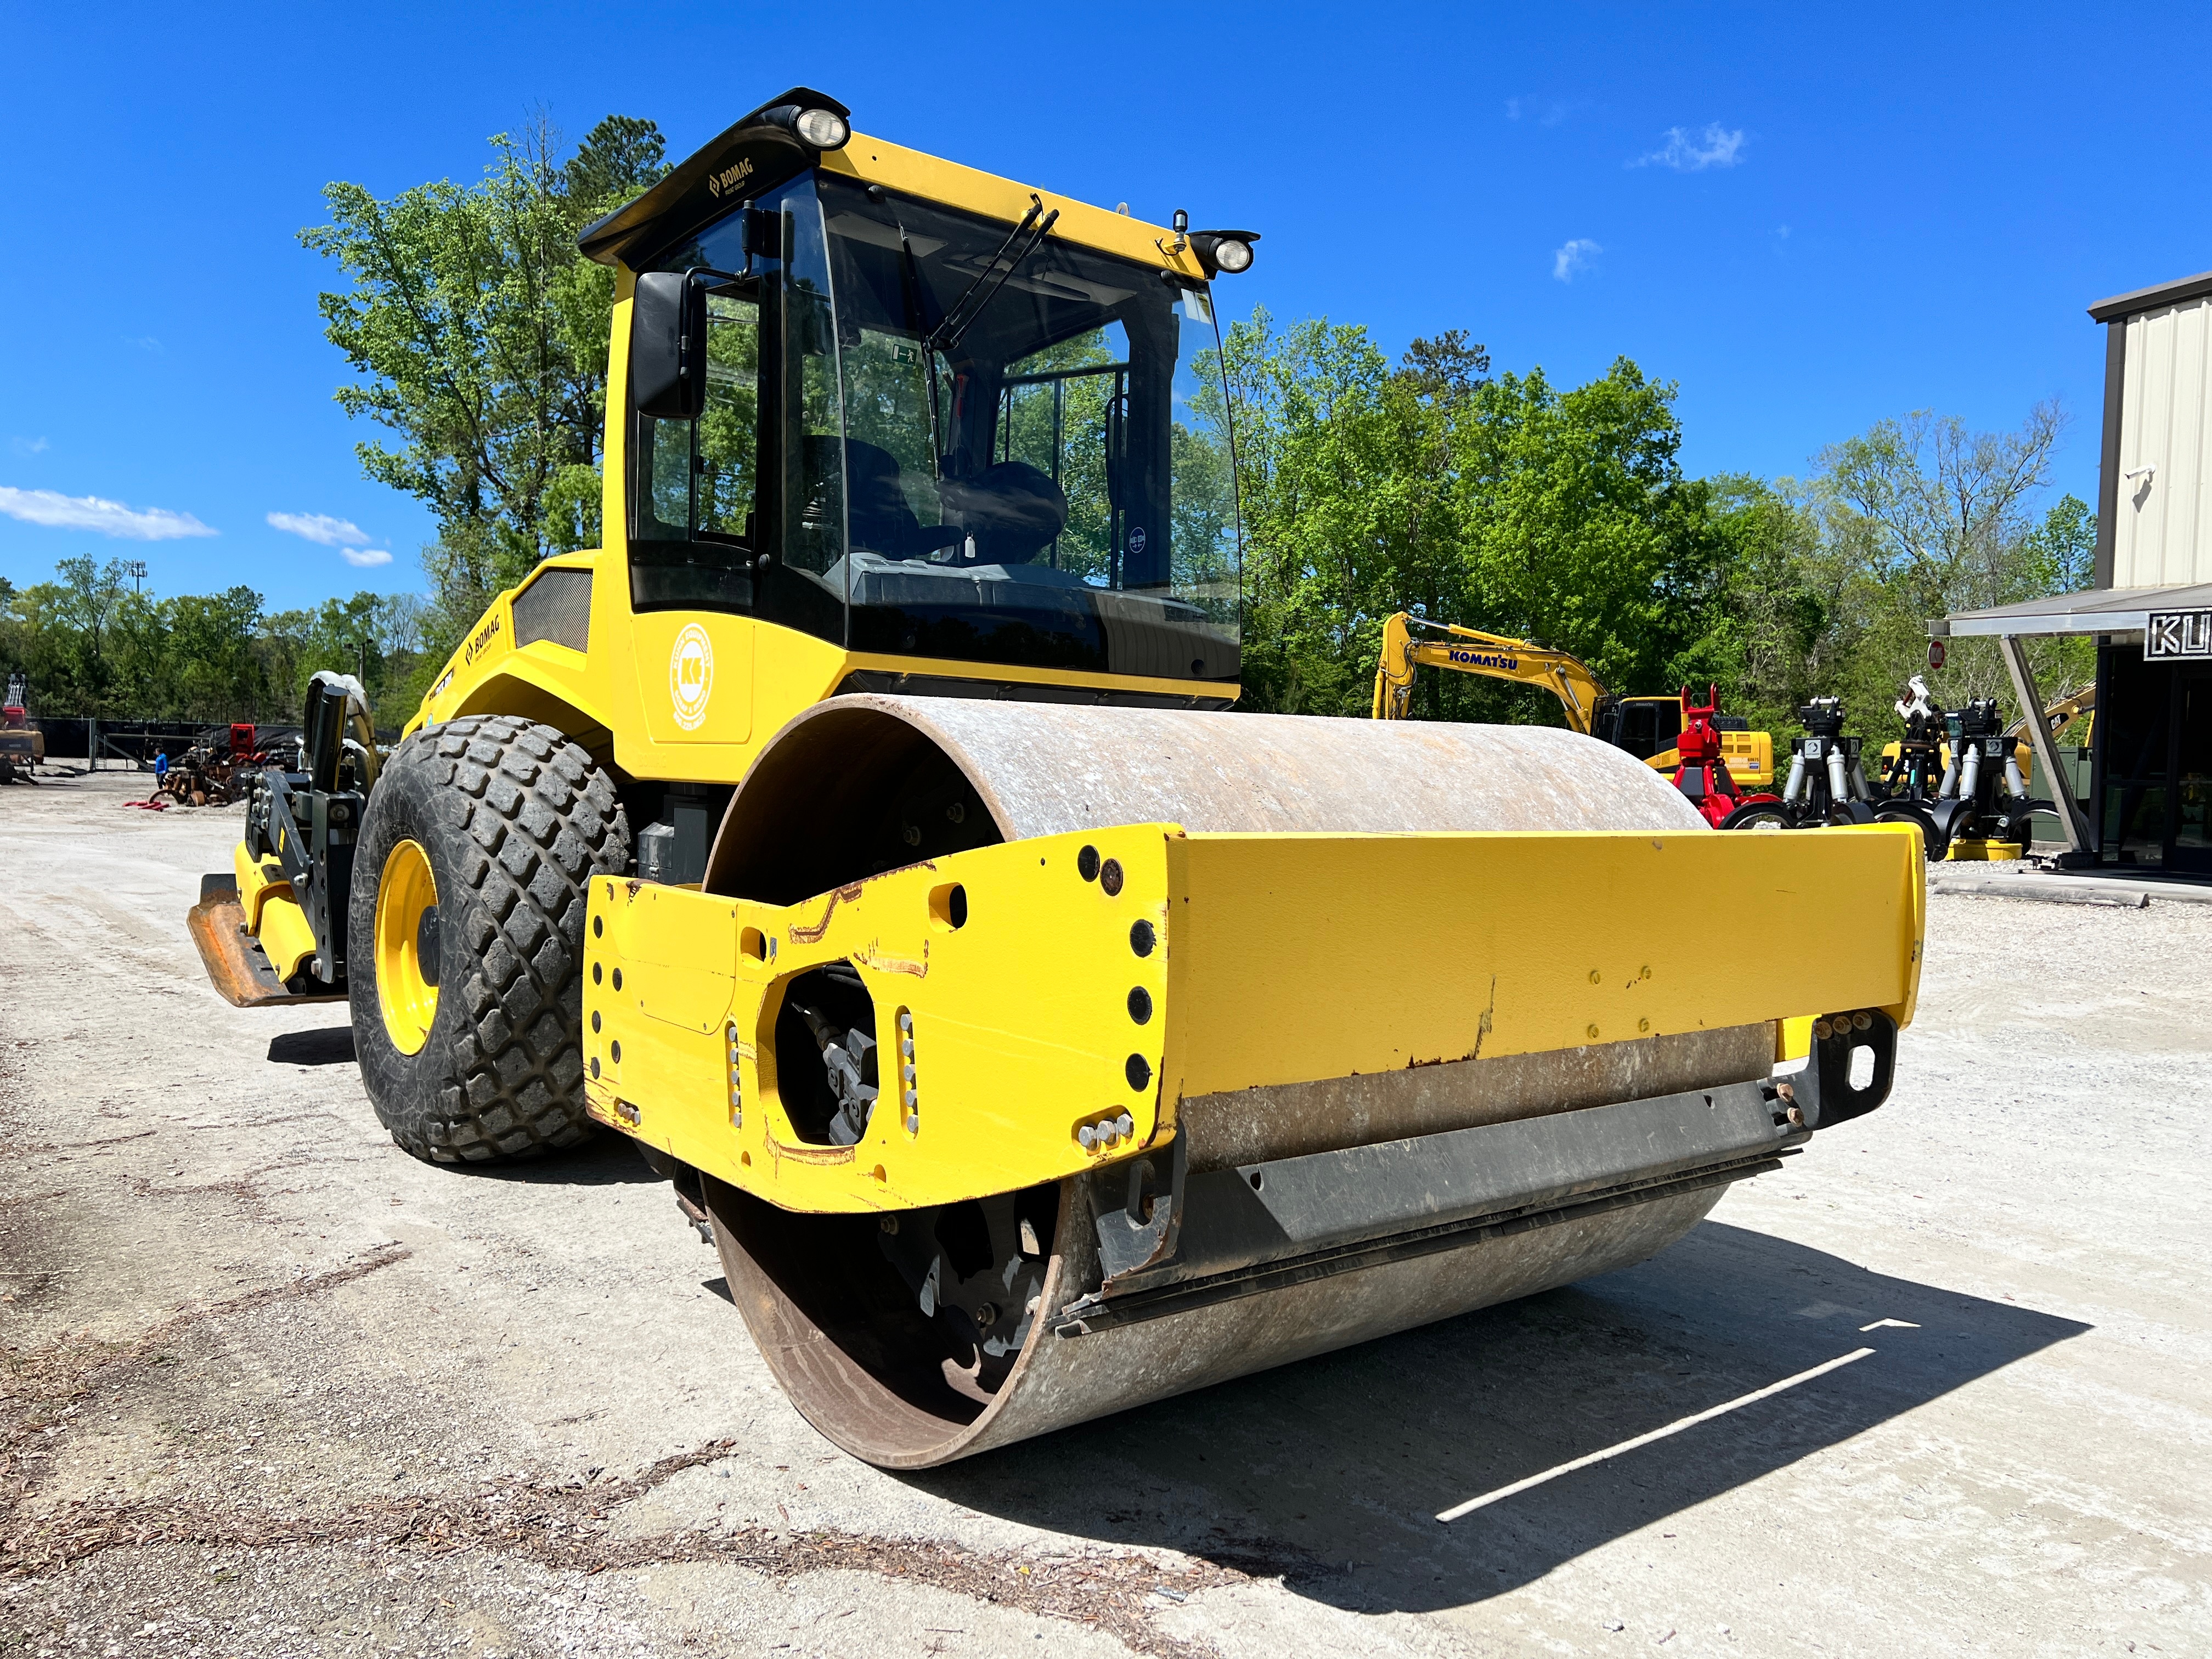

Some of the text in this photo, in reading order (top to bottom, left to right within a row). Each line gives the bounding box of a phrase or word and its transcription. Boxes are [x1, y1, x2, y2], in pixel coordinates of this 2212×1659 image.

[719, 157, 753, 189] BOMAG
[475, 614, 500, 654] BOMAG
[673, 629, 711, 669] KUHN EQUIPMENT
[2151, 614, 2212, 654] KU
[1448, 650, 1518, 670] KOMATSU
[674, 689, 688, 712] SCRAP
[693, 689, 707, 712] DEMO
[2050, 714, 2061, 730] CAT
